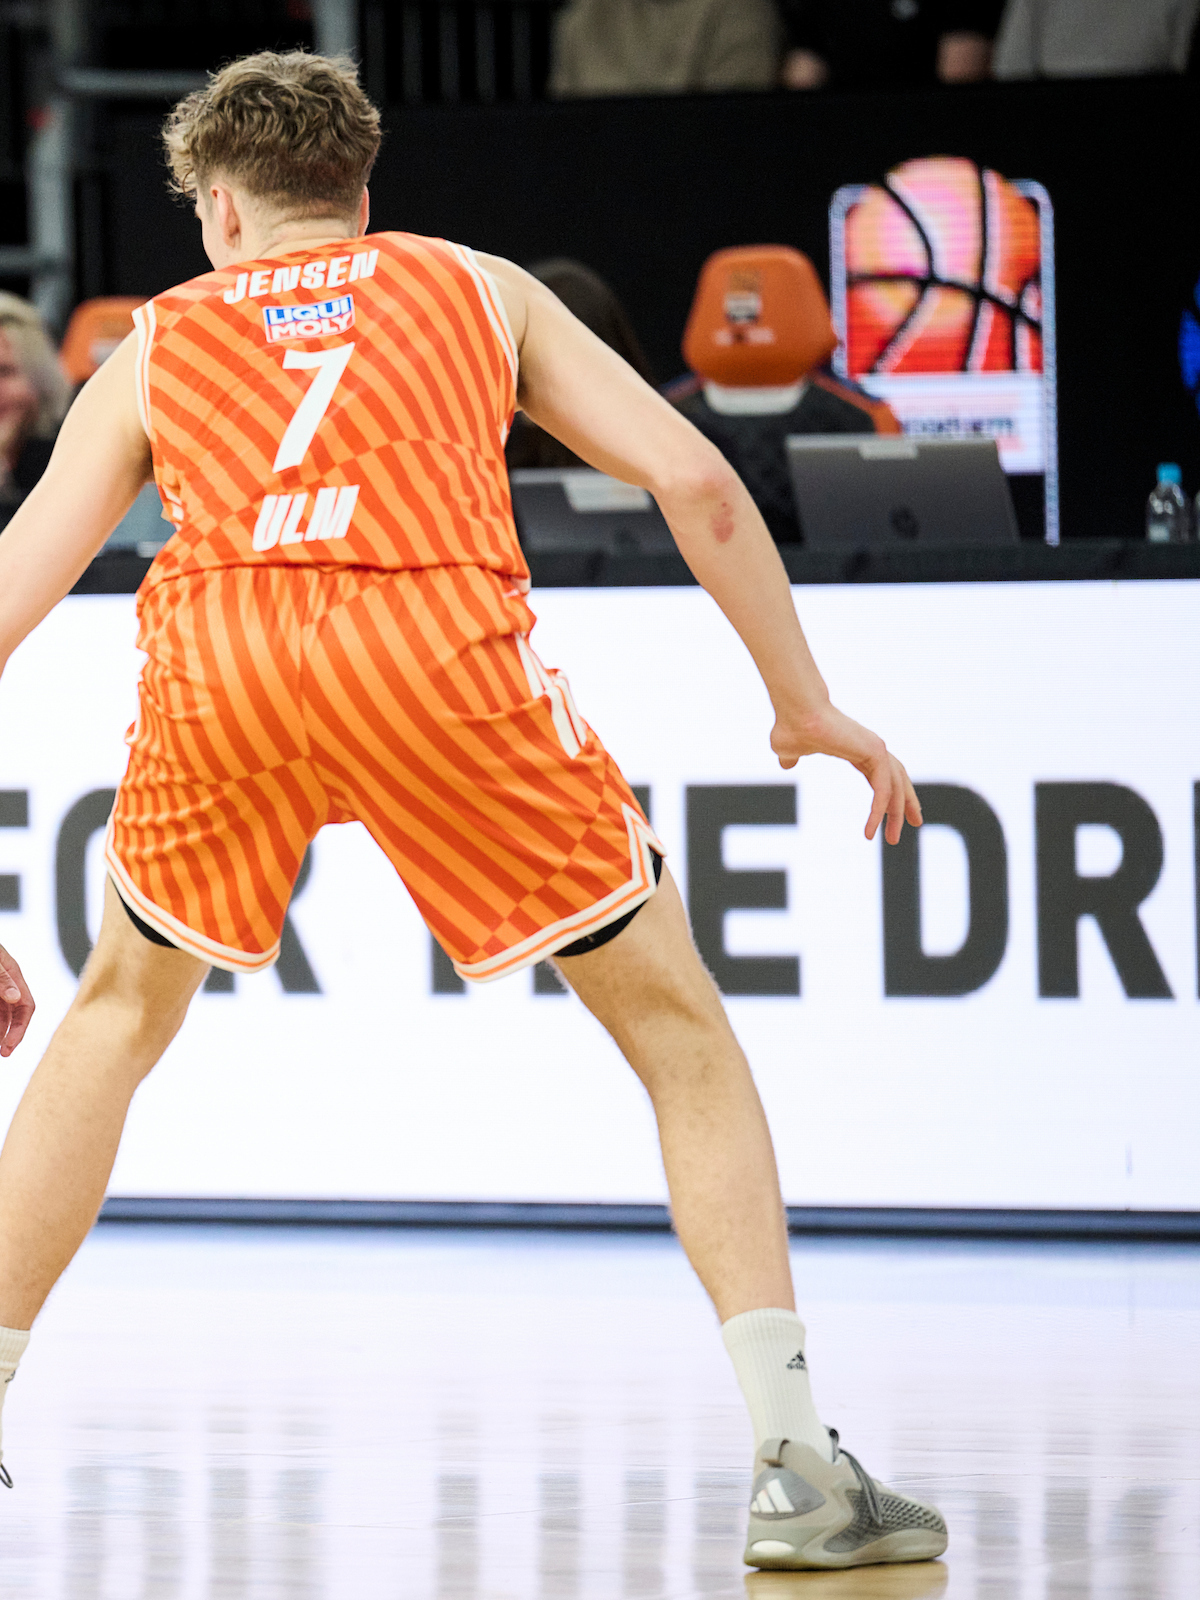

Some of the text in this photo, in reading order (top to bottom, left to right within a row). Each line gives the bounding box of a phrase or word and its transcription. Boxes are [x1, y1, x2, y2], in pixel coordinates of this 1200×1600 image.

[223, 249, 380, 304] JENSEN
[268, 297, 351, 325] LIQUI
[271, 316, 352, 339] MOLY
[272, 342, 356, 474] 7
[252, 485, 360, 552] ULM
[881, 782, 1200, 1000] DR
